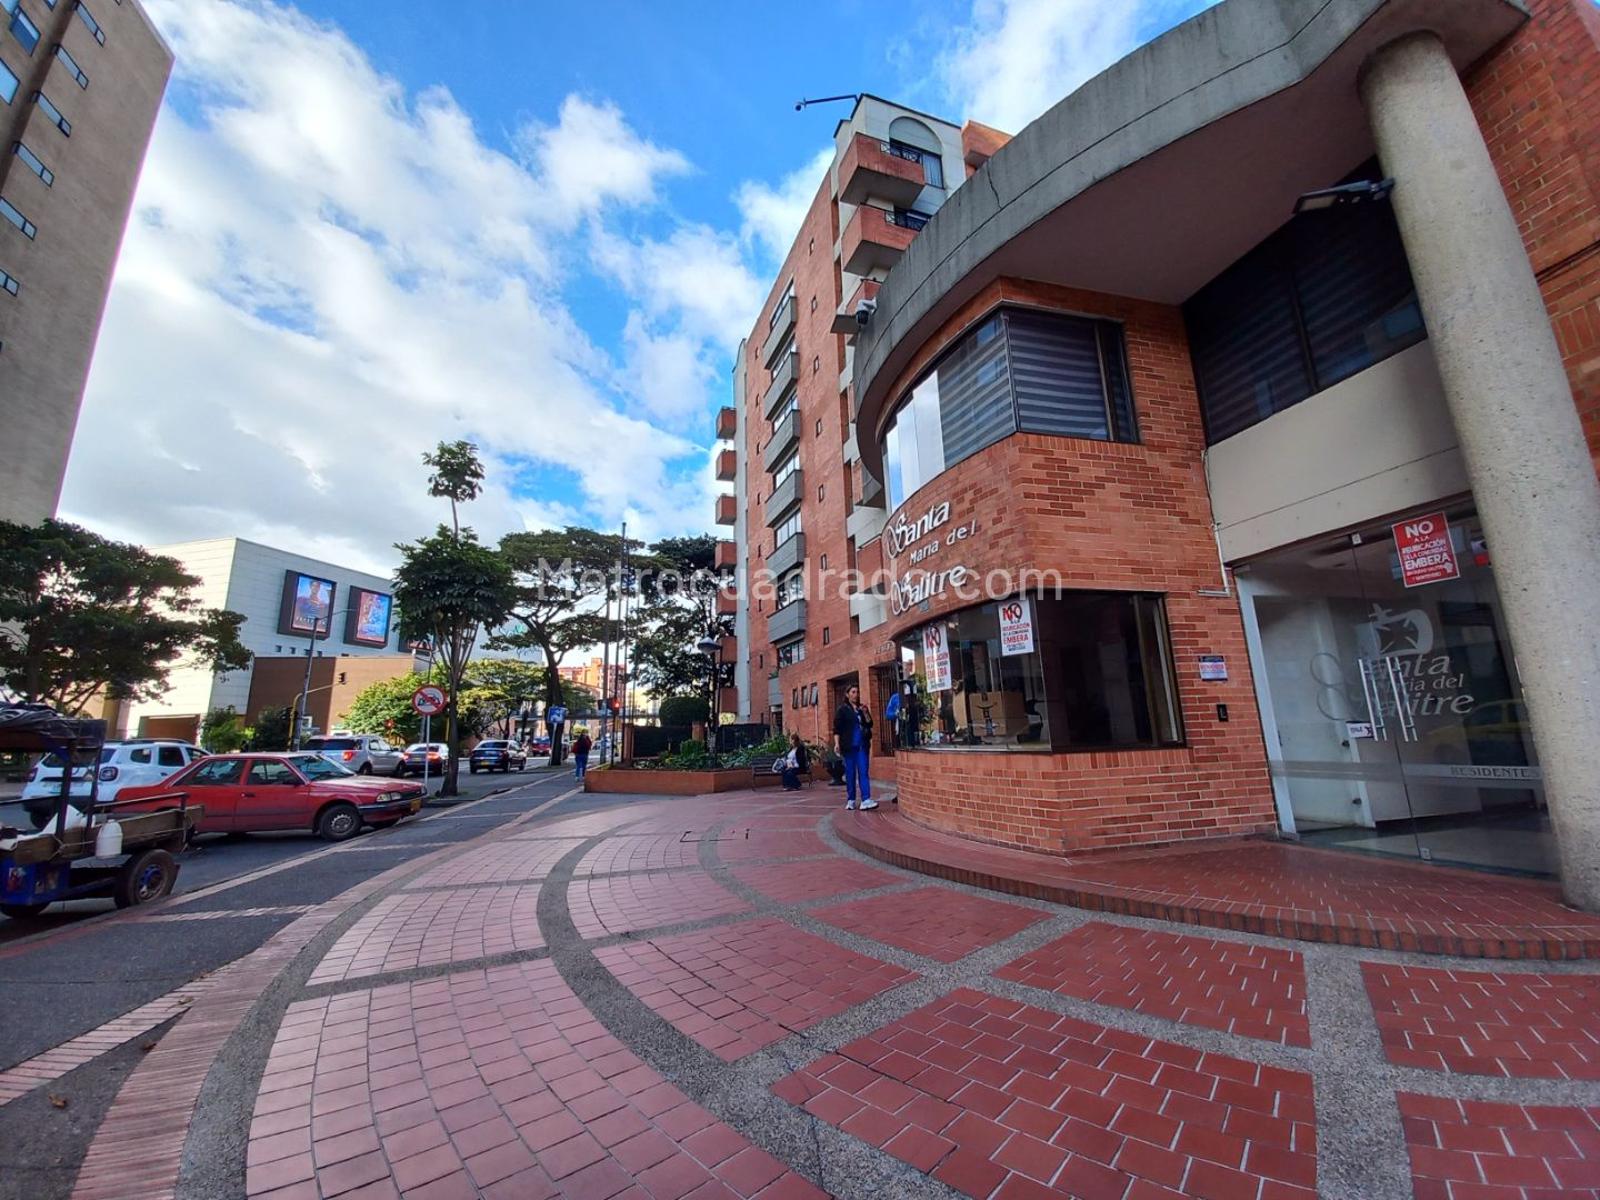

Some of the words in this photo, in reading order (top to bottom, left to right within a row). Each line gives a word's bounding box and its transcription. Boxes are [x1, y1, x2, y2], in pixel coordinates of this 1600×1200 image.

[887, 501, 951, 559] Santa
[909, 540, 940, 566] Maria
[946, 519, 977, 545] del
[1405, 520, 1435, 538] NO
[1405, 552, 1451, 570] EMBERA
[891, 565, 968, 616] Salitre
[1432, 673, 1464, 689] del
